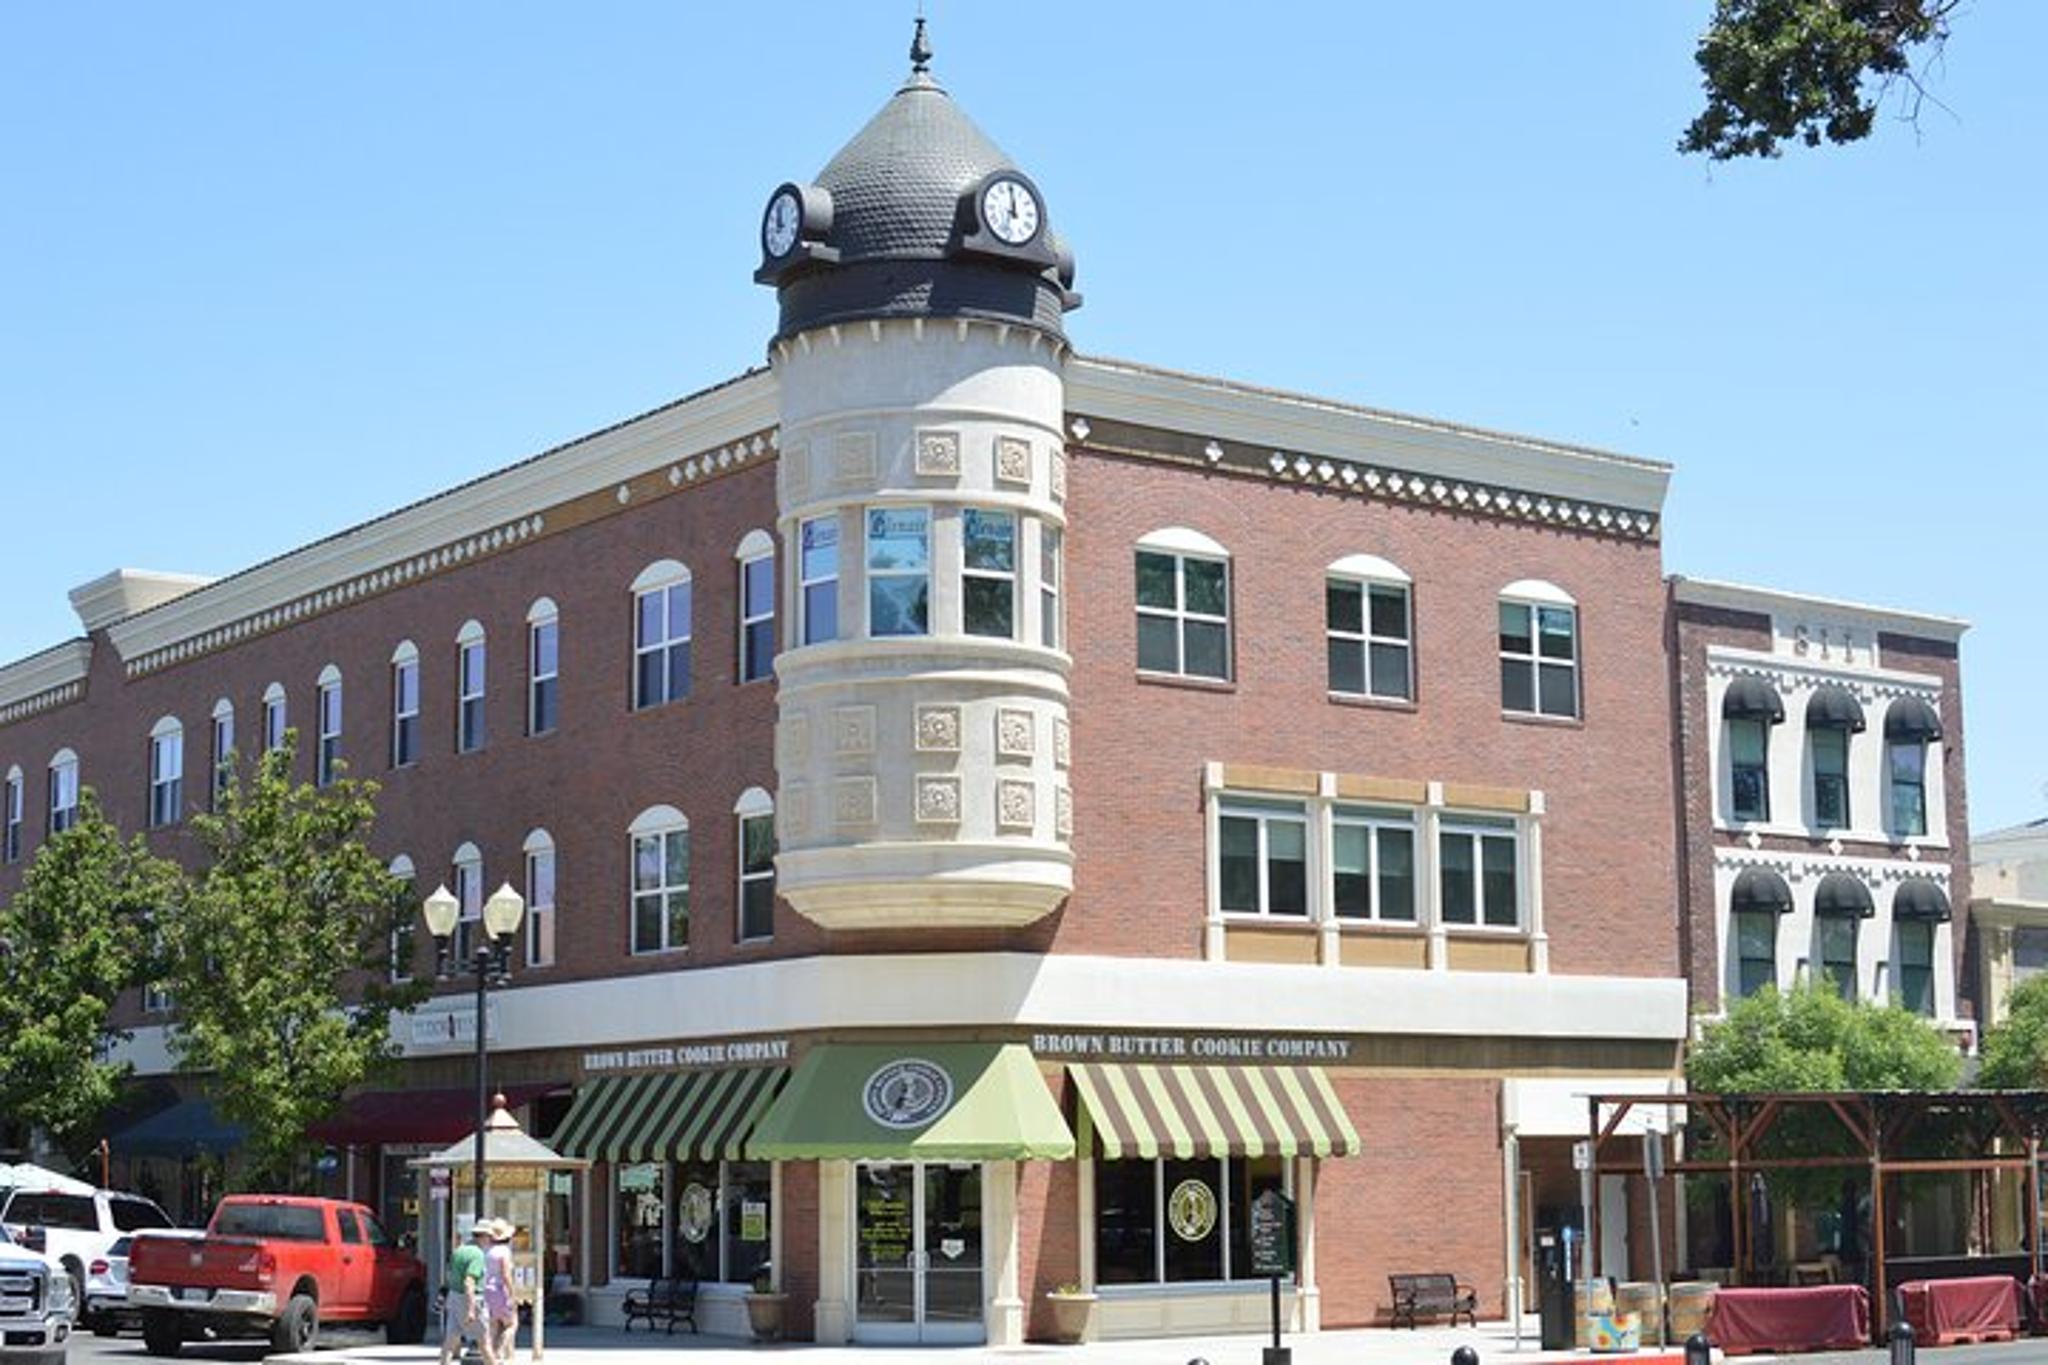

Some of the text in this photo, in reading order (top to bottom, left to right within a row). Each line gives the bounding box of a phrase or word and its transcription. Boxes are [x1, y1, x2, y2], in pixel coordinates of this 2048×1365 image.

[677, 1044, 725, 1065] COOKIE
[728, 1041, 787, 1060] COMPANY
[1033, 1033, 1351, 1059] BROWN BUTTER COOKIE COMPANY
